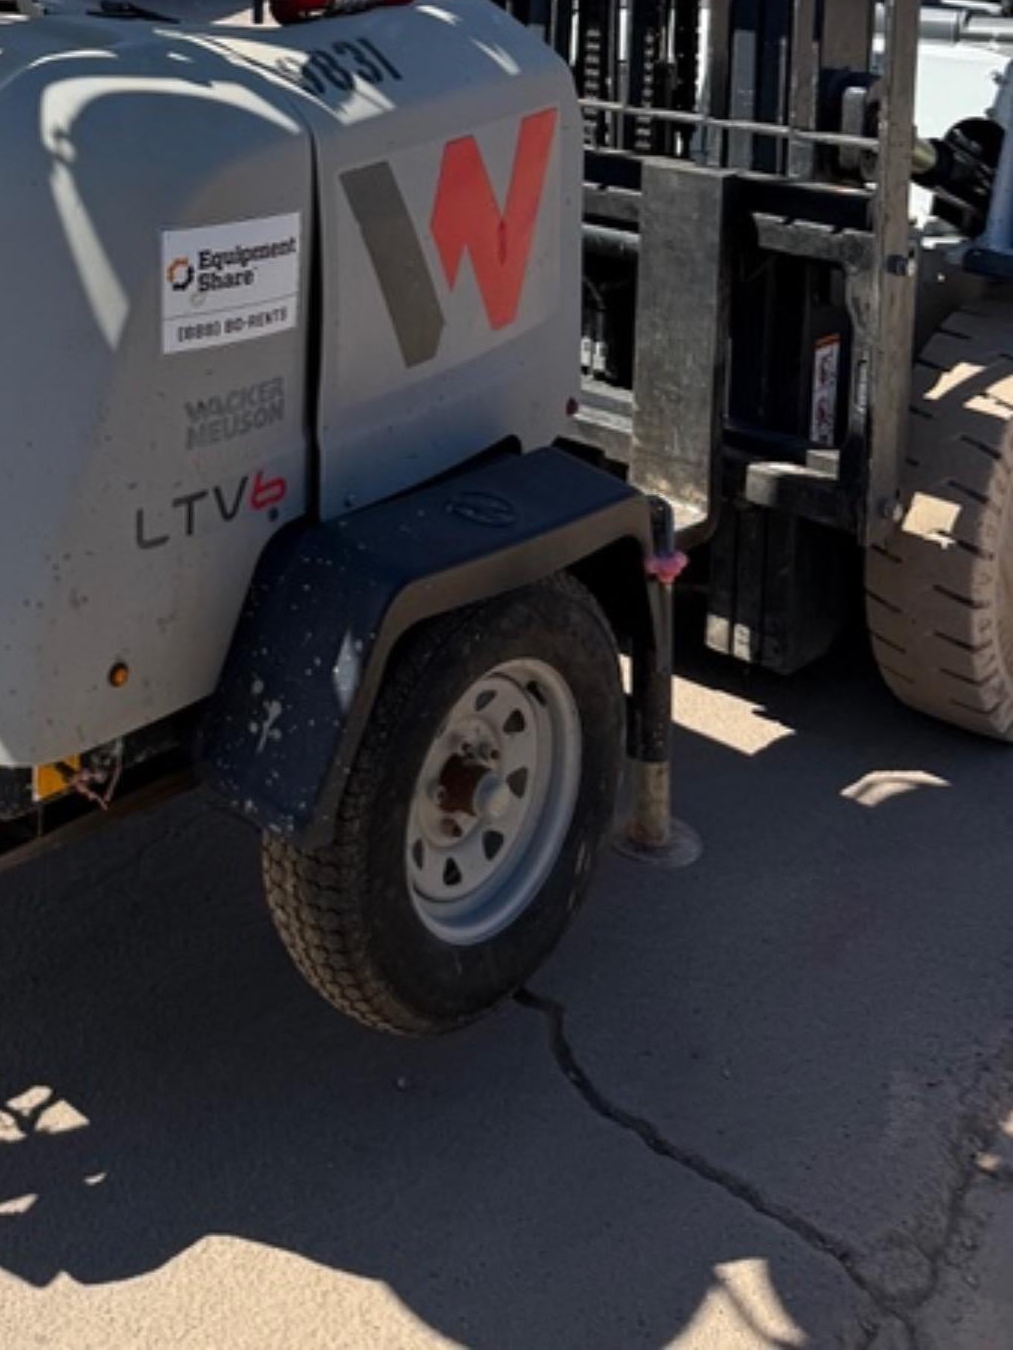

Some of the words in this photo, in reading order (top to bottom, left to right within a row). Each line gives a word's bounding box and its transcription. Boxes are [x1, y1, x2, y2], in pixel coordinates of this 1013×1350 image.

[197, 236, 297, 271] Equipment
[197, 269, 255, 293] Share
[184, 376, 284, 421] WACKER
[185, 400, 284, 450] NEUSON
[136, 470, 286, 549] LTV6
